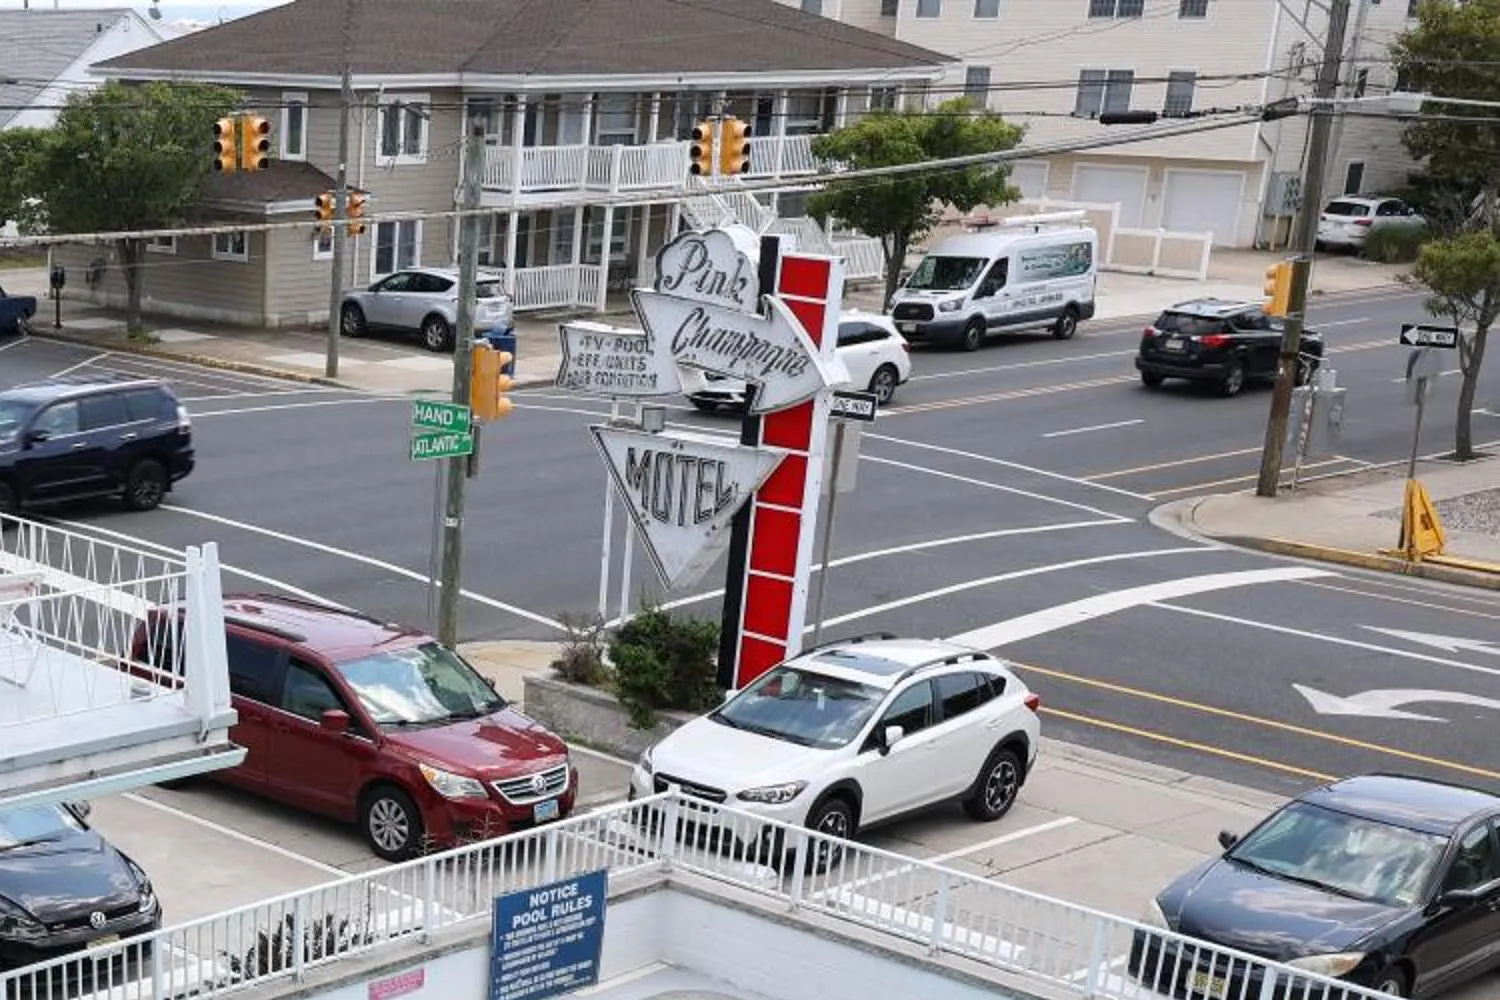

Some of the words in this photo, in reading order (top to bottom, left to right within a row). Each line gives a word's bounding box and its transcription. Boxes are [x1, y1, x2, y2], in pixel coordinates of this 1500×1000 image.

[664, 239, 747, 304] Pink
[671, 307, 808, 377] Champagne
[414, 403, 453, 425] HAND
[415, 435, 459, 453] ATLANTIC
[625, 447, 733, 526] MOTEL
[512, 908, 548, 930] POOL
[551, 895, 593, 918] RULES
[529, 883, 579, 908] NOTICE
